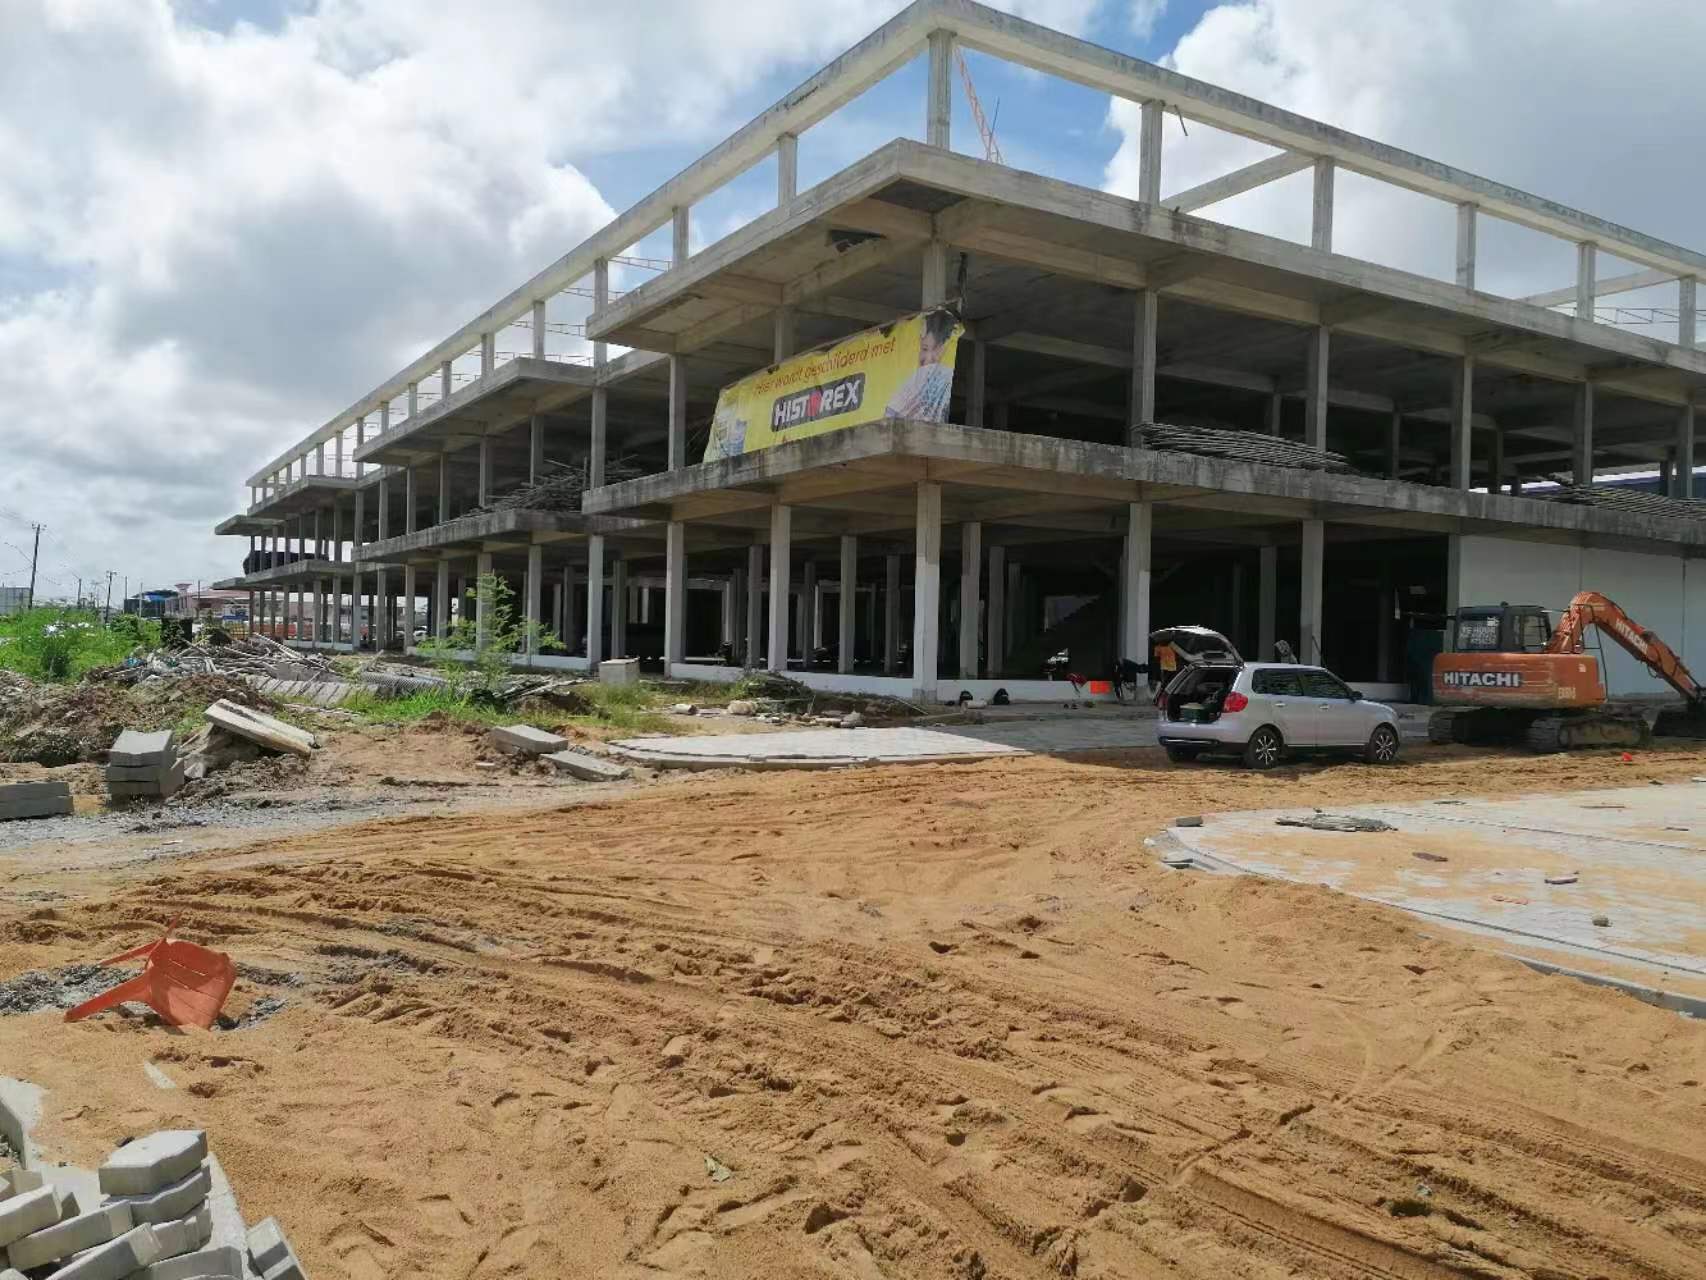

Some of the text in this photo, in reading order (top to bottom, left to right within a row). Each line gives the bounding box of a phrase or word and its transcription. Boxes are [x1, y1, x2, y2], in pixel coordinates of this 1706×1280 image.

[871, 337, 896, 356] met
[774, 379, 861, 426] HISTOREX
[1615, 618, 1648, 655] HITACHI
[1443, 672, 1520, 687] HITACHI
